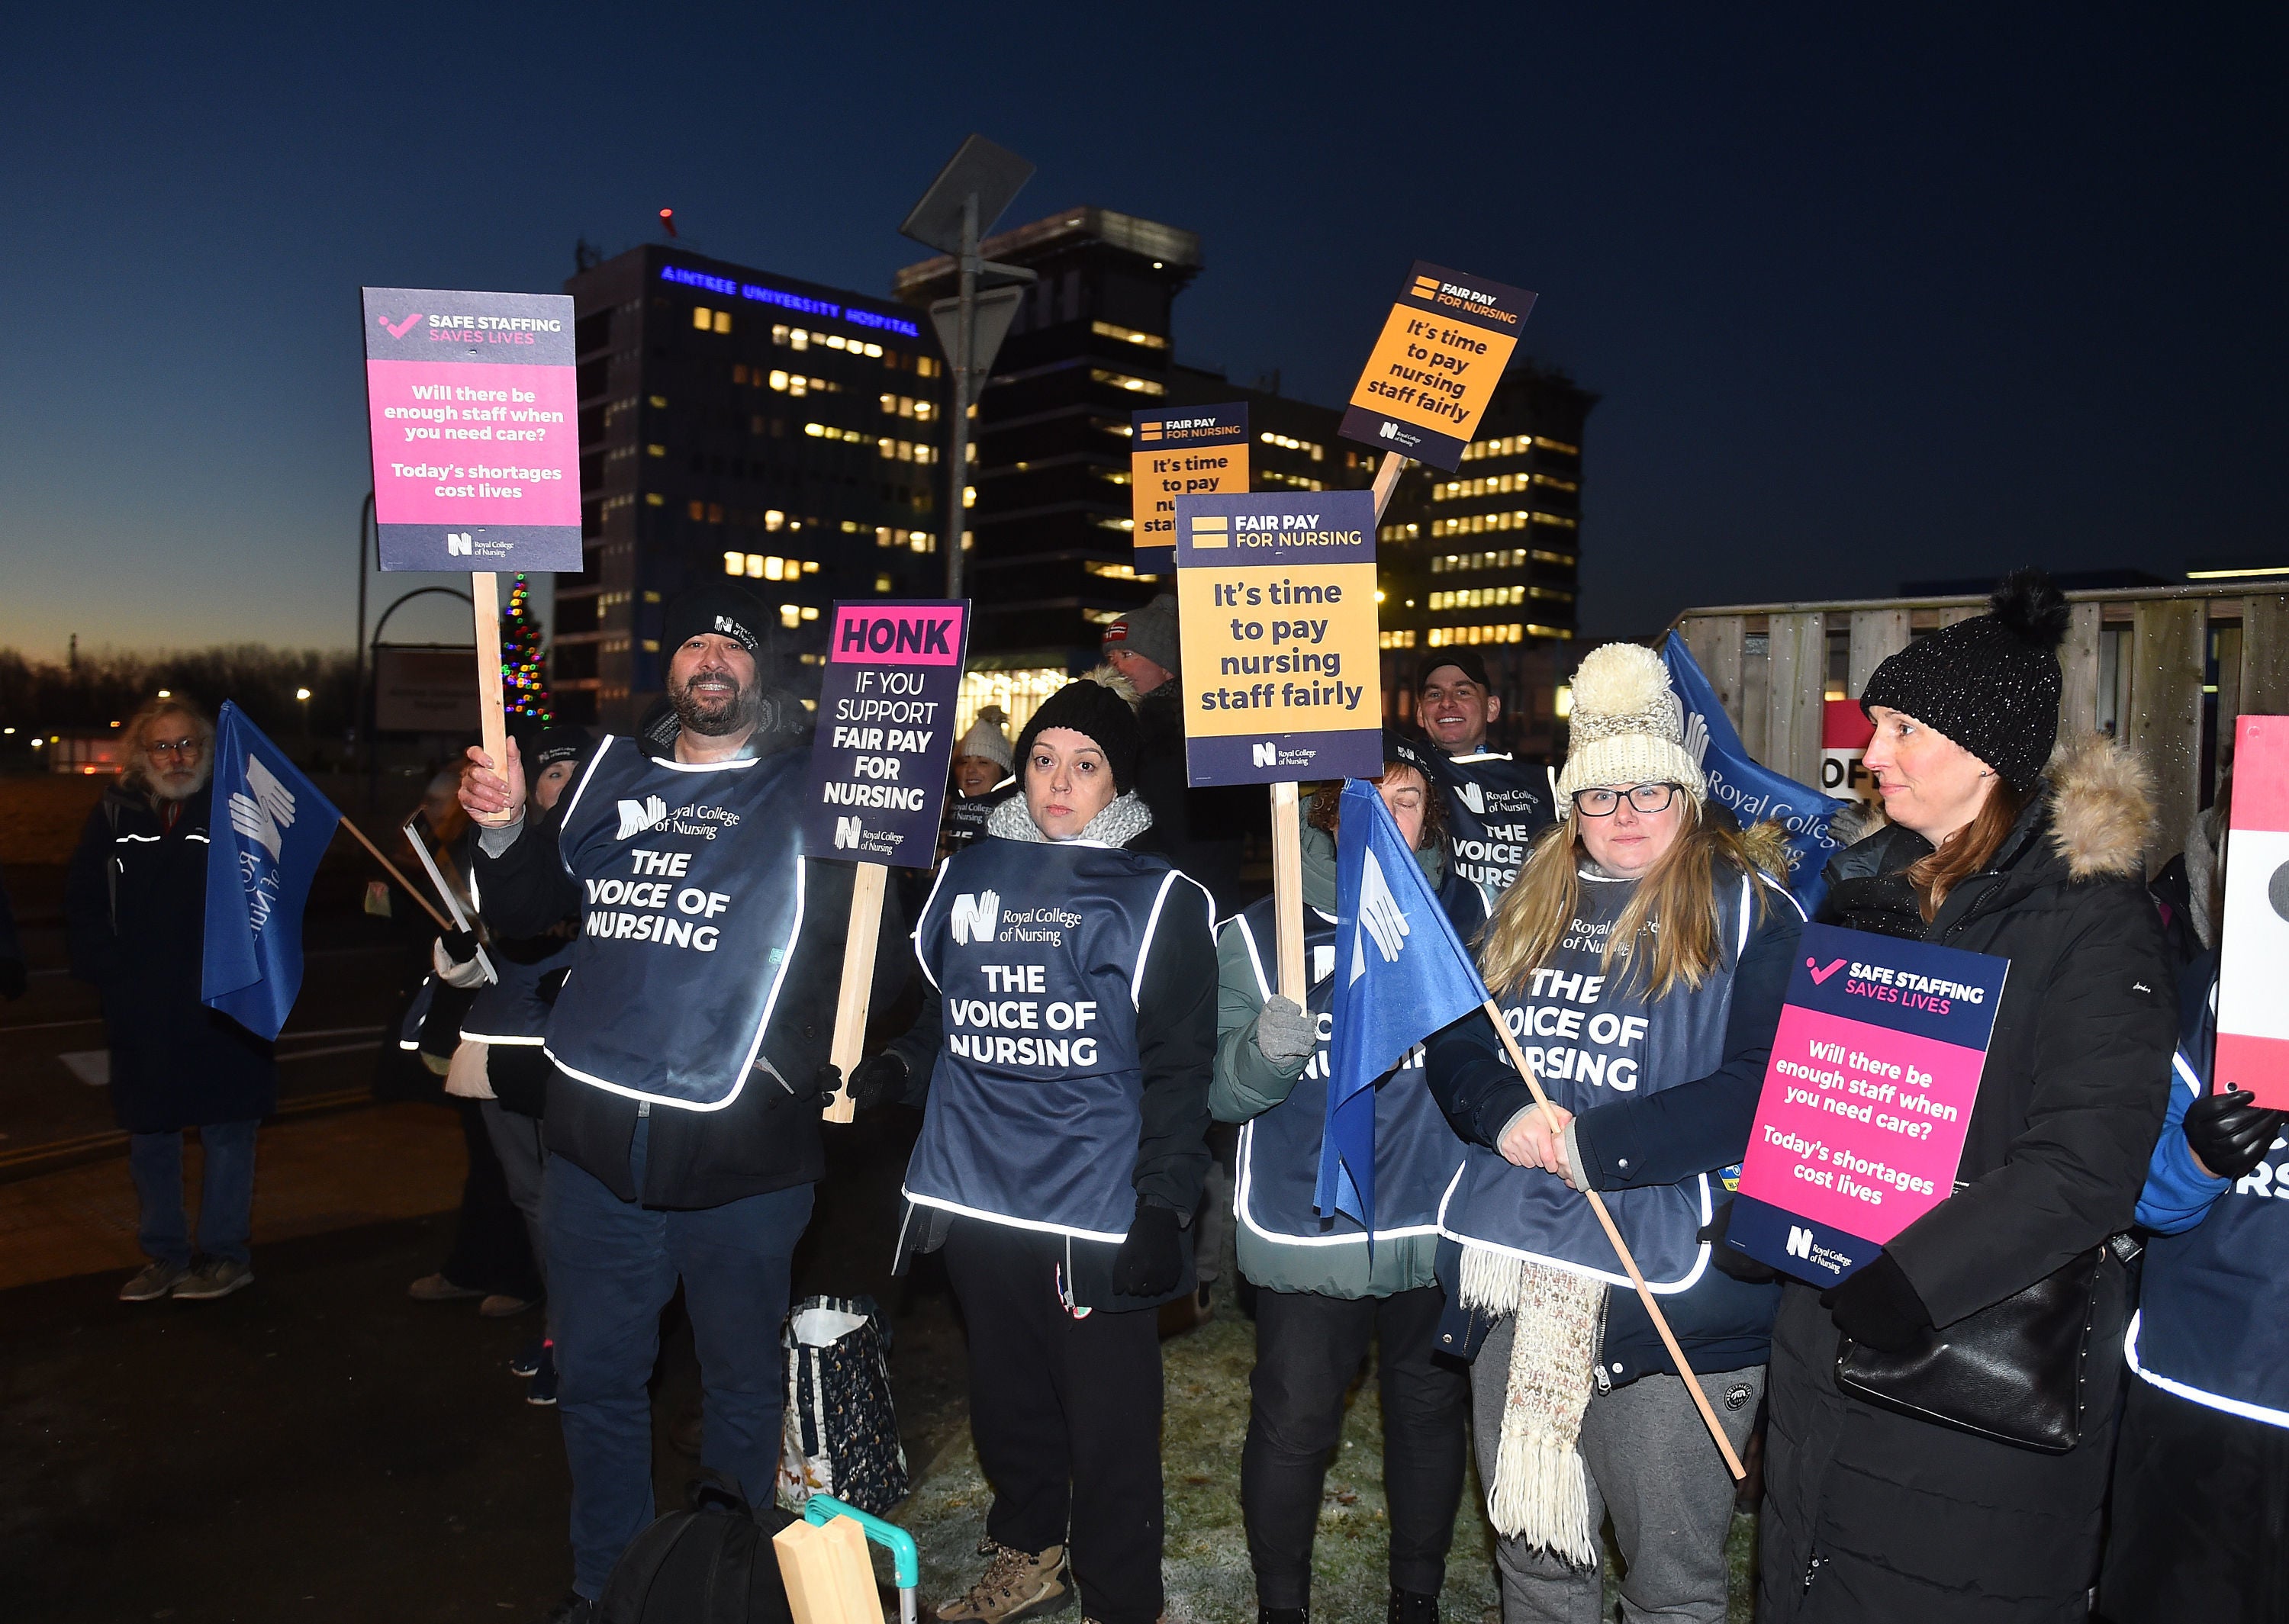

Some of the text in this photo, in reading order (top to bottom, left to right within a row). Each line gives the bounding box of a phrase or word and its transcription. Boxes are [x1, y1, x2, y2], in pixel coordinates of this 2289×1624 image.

[661, 266, 919, 338] AINTREE UNIVERSITY HOSPITAL
[1441, 284, 1497, 306] FAIR PAY
[1437, 294, 1518, 324] FOR NURSING
[429, 314, 562, 333] SAFE STAFFING
[430, 330, 535, 345] SAVES LIVES
[1407, 319, 1487, 355] It's time
[1408, 343, 1470, 375] to pay
[1389, 362, 1466, 399] nursing
[412, 385, 536, 404] Will there be
[1367, 380, 1470, 424] staff fairly
[384, 406, 564, 424] enough staff when
[1166, 418, 1216, 430] FAIR PAY
[404, 425, 546, 442] you need care?
[1167, 425, 1241, 439] FOR NURSING
[391, 463, 562, 482] Today's shortages
[1154, 455, 1228, 473] It's time
[435, 484, 523, 498] cost lives
[1162, 477, 1220, 494] to pay
[1235, 514, 1321, 532] FAIR PAY
[492, 541, 514, 550] College
[1235, 530, 1362, 548] FOR NURSING
[482, 549, 506, 558] Nursing
[1214, 579, 1342, 607] It's time
[840, 619, 955, 654] HONK
[1231, 618, 1328, 645] to pay
[1221, 647, 1341, 677] nursing
[855, 671, 926, 696] IF YOU
[1201, 680, 1363, 711] staff fairly
[835, 698, 938, 725] SUPPORT
[832, 726, 933, 754] FAIR PAY
[1286, 757, 1309, 767] Nursing
[1295, 749, 1317, 757] College
[854, 756, 900, 780] FOR
[823, 781, 926, 812] NURSING
[1486, 790, 1510, 802] Royal
[1707, 770, 1770, 816] Royal
[670, 803, 740, 827] yal College
[957, 812, 983, 825] Nursing
[1489, 802, 1532, 814] of Nursing
[655, 818, 718, 840] of Nursing
[863, 829, 904, 844] Royal College
[1483, 822, 1529, 842] THE
[861, 841, 893, 856] of Nursing
[1453, 837, 1523, 864] VOICE
[631, 848, 692, 878] THE
[1454, 860, 1520, 888] NURS
[585, 878, 731, 919] VOICE OF
[1002, 907, 1082, 928] Royal College
[1570, 918, 1611, 939] Royal
[585, 910, 720, 952] NURSING
[1000, 928, 1061, 947] of Nursing
[1563, 936, 1583, 950] of
[980, 965, 1046, 993] THE
[1530, 967, 1606, 1004] THE
[1849, 962, 1985, 1004] SAFE STAFFING
[1845, 979, 1952, 1015] SAVES LIVES
[950, 999, 1097, 1031] VOICE OF
[1588, 1012, 1649, 1048] OF
[949, 1034, 1098, 1067] NURSING
[1498, 1046, 1639, 1092] RSING
[1808, 1039, 1933, 1089] Will there be
[1776, 1059, 1959, 1123] enough staff when
[1784, 1085, 1933, 1141] you need care?
[1763, 1124, 1935, 1195] Today's shortages
[1793, 1163, 1883, 1205] cost lives
[1813, 1243, 1853, 1267] Royal College
[1817, 1256, 1841, 1275] Nursing
